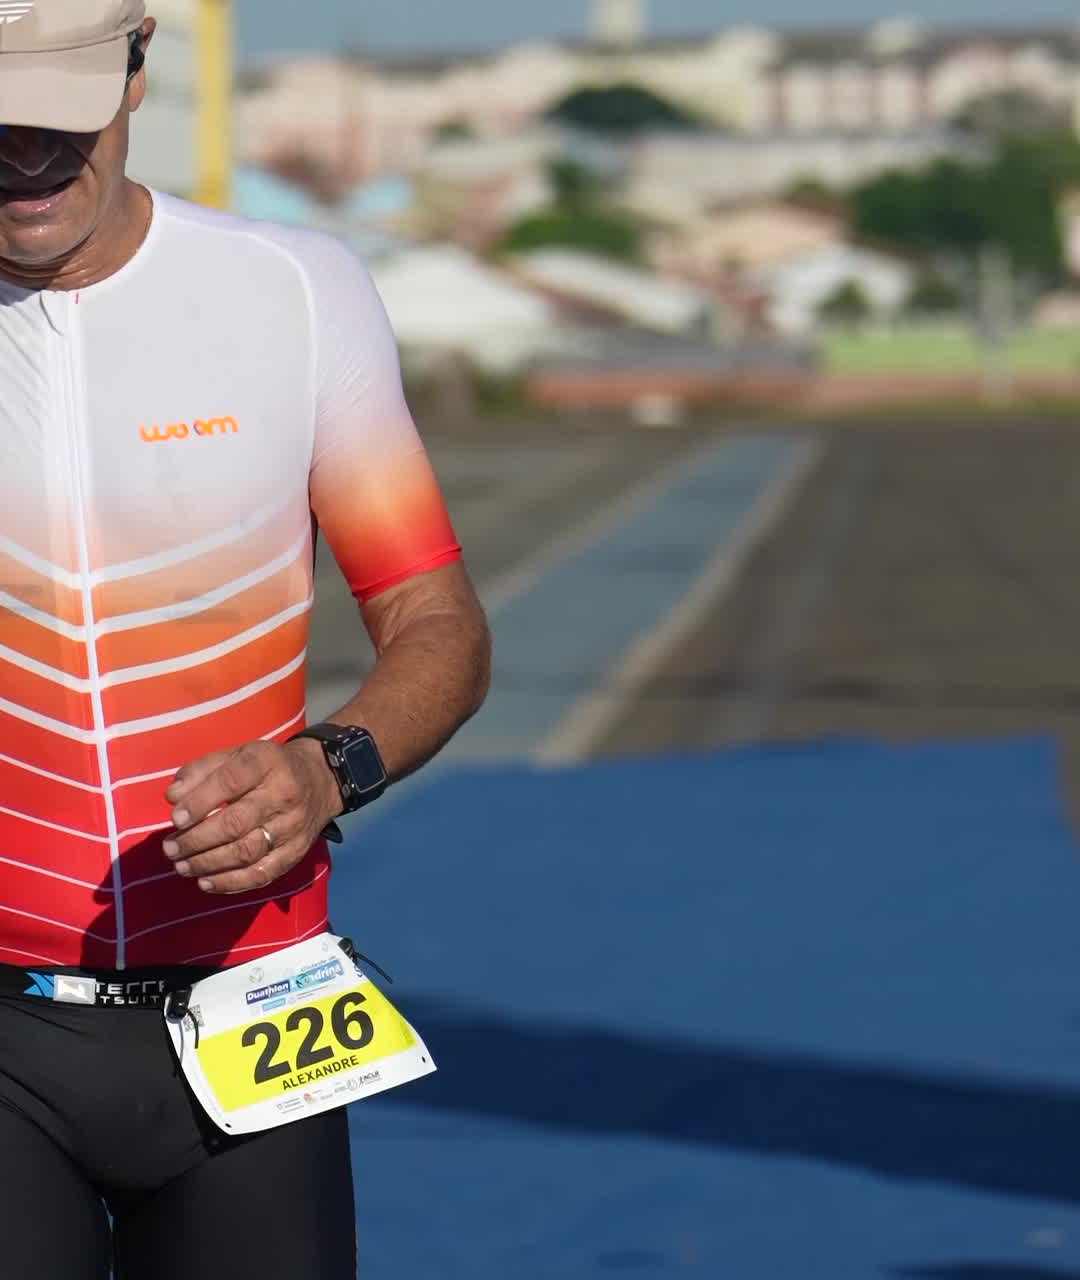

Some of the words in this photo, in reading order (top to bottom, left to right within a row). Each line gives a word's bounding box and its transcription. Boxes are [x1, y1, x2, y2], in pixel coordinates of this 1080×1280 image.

[246, 982, 289, 999] Duathlon
[241, 991, 374, 1085] 226
[282, 1055, 360, 1090] ALEXANDRE
